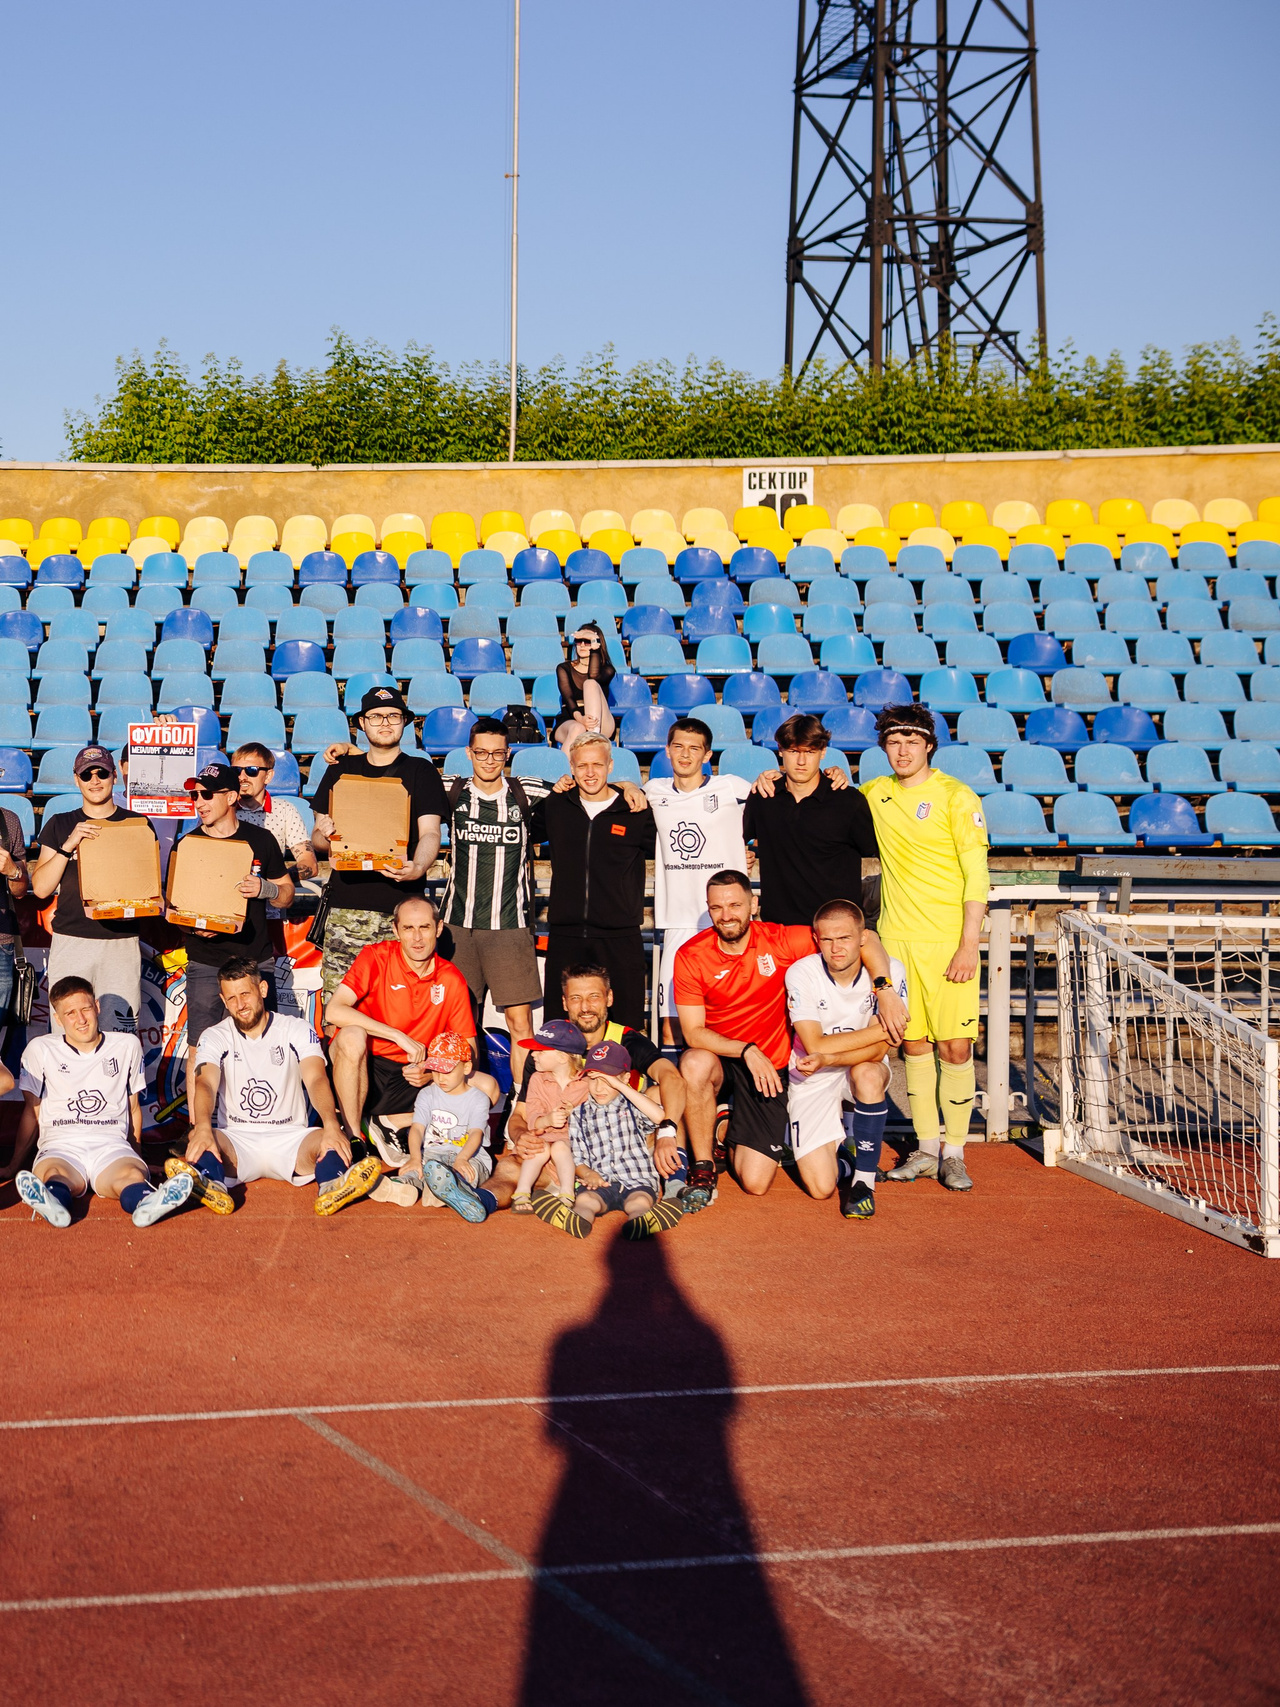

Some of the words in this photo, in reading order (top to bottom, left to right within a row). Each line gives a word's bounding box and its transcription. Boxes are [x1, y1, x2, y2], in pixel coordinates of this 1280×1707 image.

[748, 471, 807, 490] СЕКТОР
[132, 727, 193, 745] ФУТБОЛ
[456, 828, 501, 843] Viewer
[465, 821, 501, 834] Team
